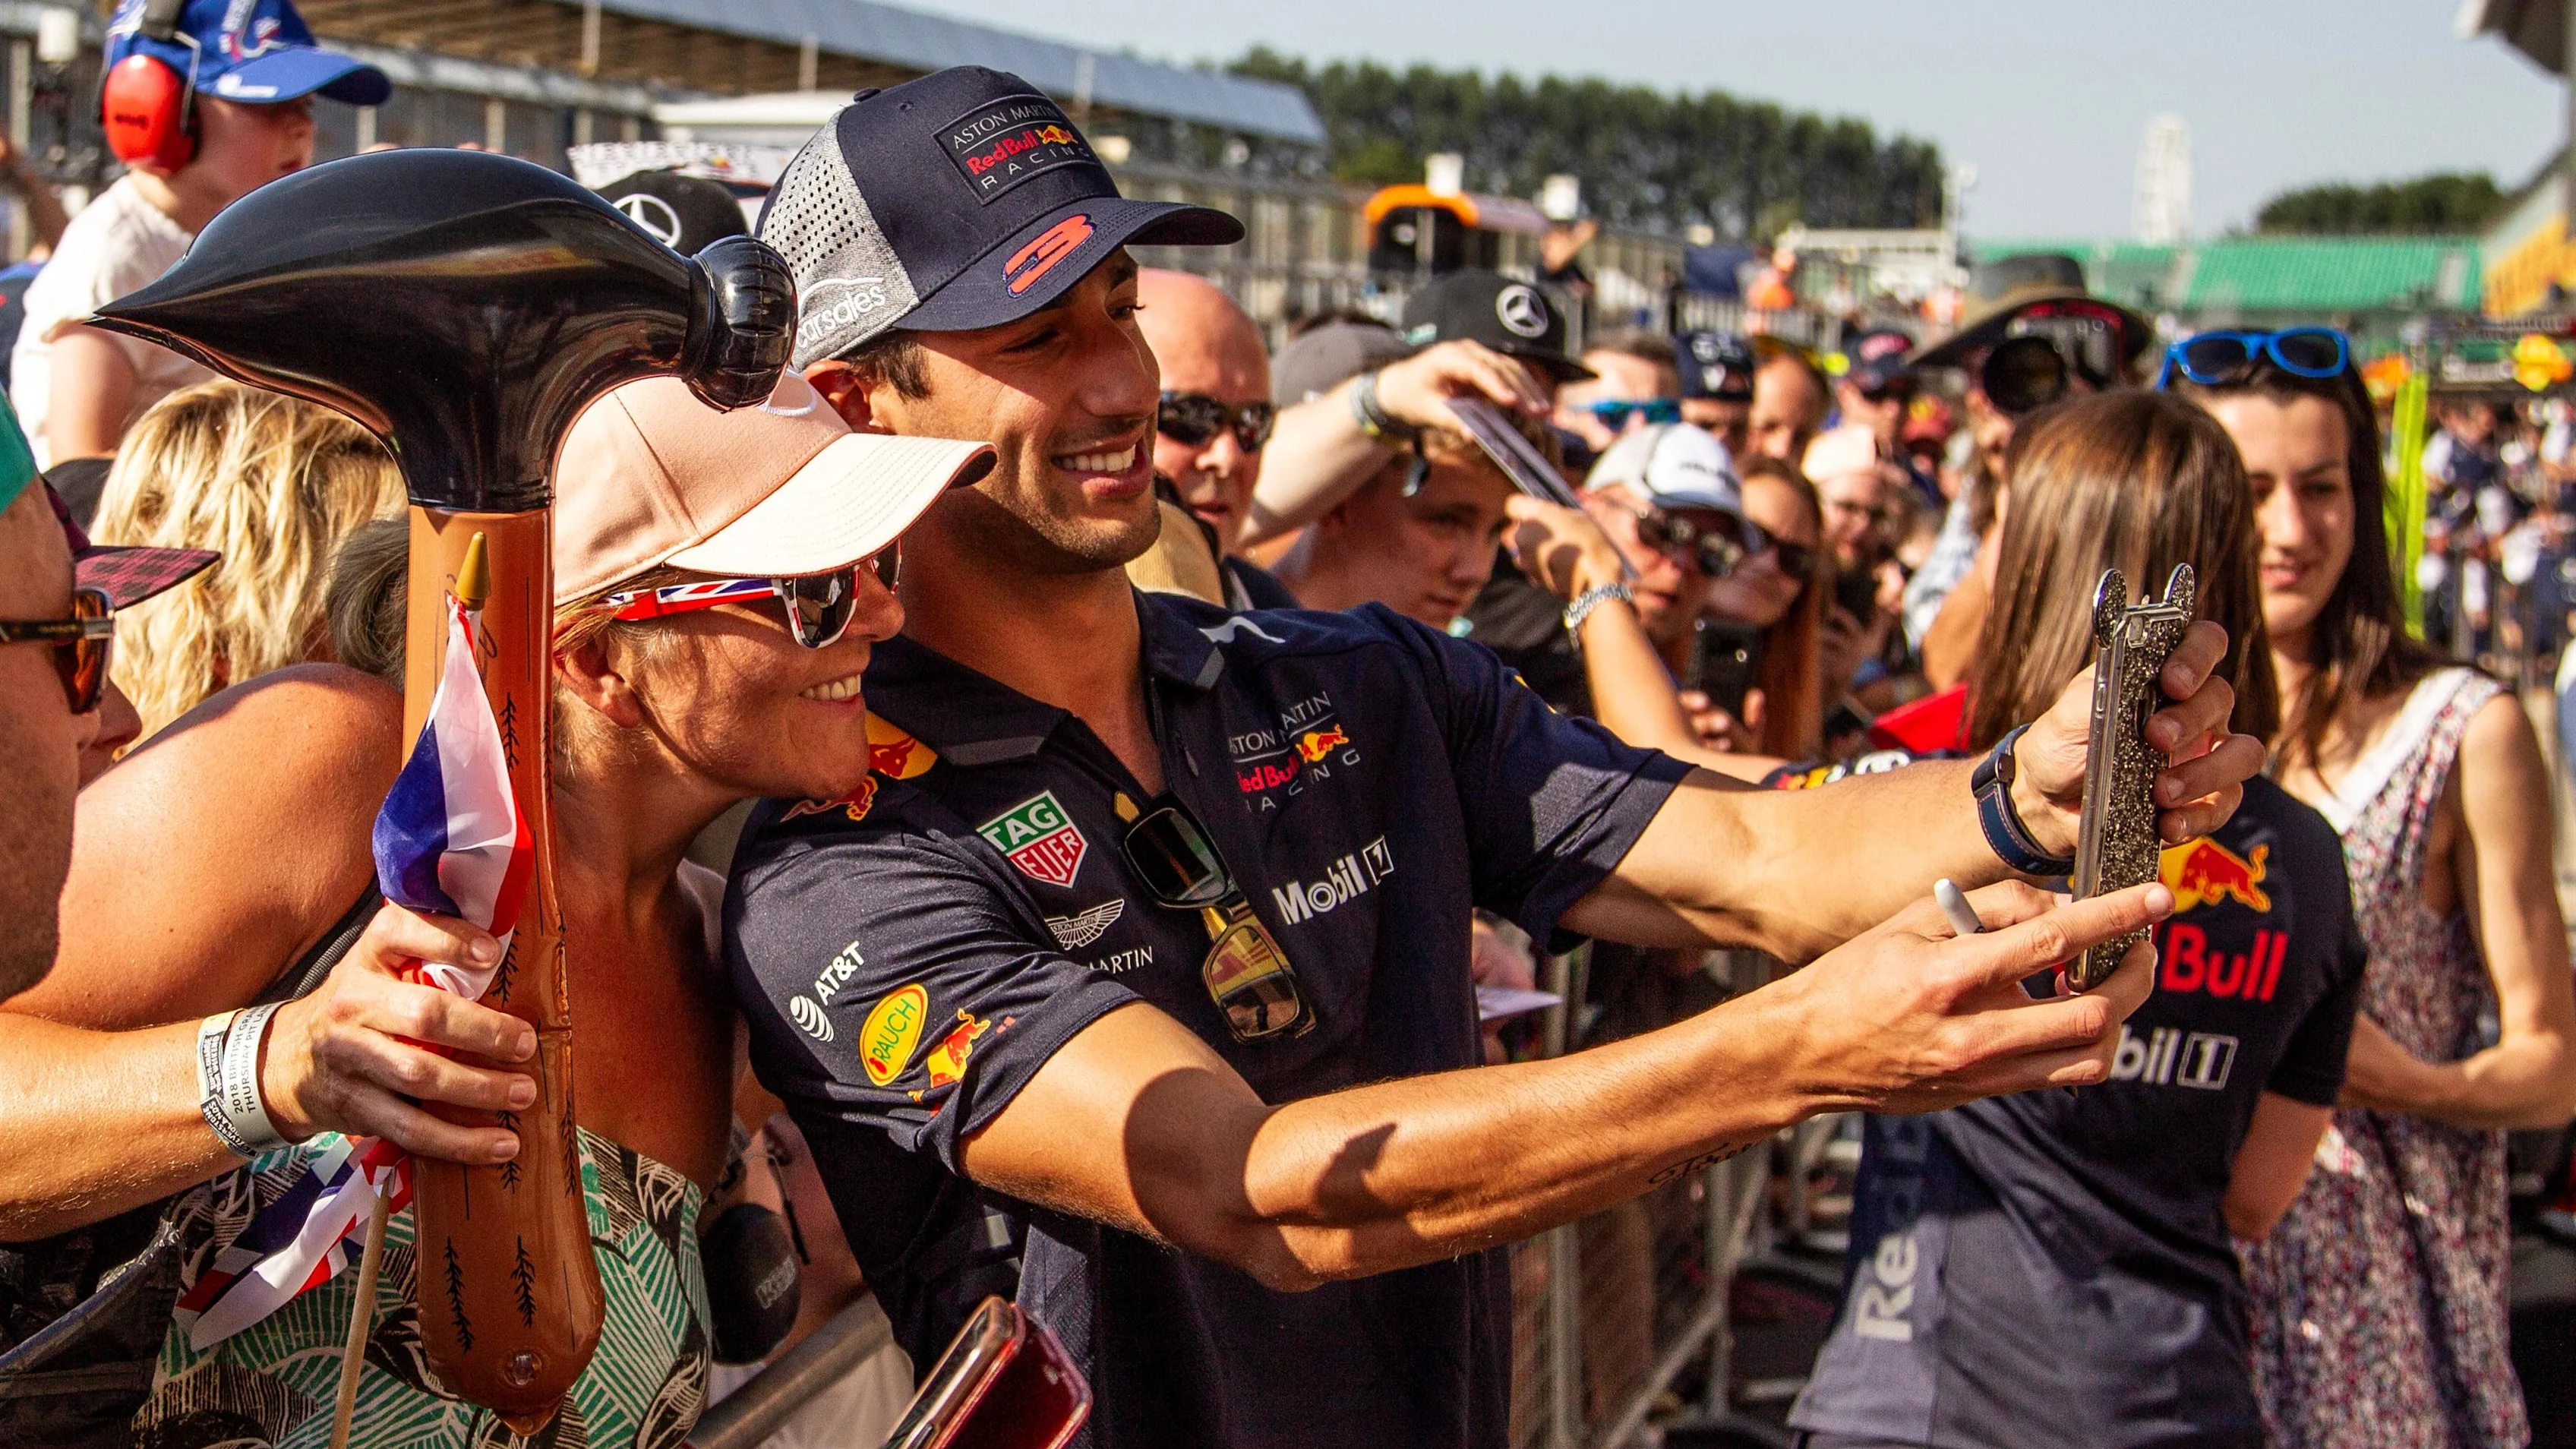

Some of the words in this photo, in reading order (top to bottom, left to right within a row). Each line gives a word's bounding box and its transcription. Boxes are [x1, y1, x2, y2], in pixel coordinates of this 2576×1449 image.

[953, 112, 1009, 150] ASTON
[797, 286, 886, 348] carsales
[982, 803, 1060, 852] TAG
[1016, 831, 1080, 882] EUER
[1271, 854, 1368, 926] Mobil
[814, 941, 864, 1006] AT&T
[229, 1033, 244, 1081] BRITISH
[246, 1025, 258, 1040] PIT
[872, 997, 917, 1064] RAUCH
[2108, 1024, 2182, 1084] bil
[229, 1083, 244, 1114] 2018
[241, 1045, 257, 1114] THURSDAY
